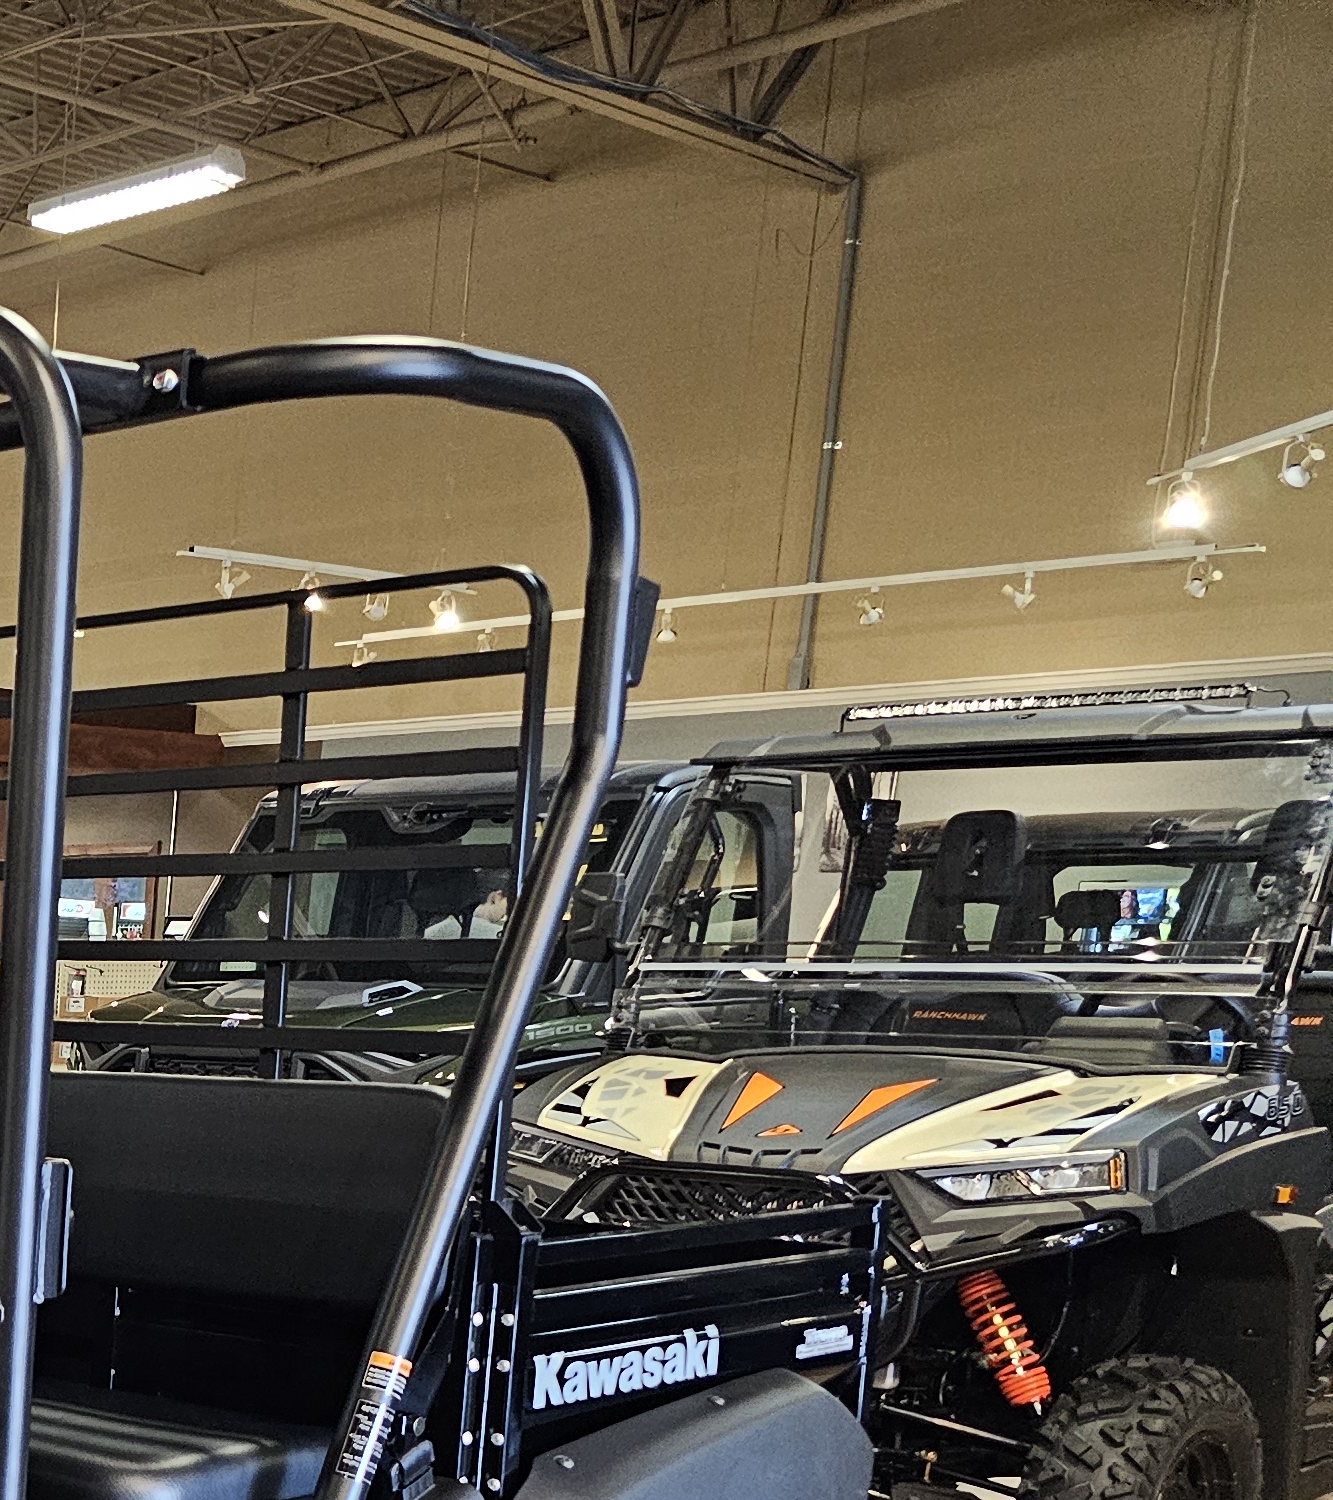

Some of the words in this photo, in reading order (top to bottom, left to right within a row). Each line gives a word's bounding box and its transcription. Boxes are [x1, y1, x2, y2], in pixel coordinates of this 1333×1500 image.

[912, 1010, 988, 1021] RANCHHAWK
[527, 1023, 592, 1041] 1500
[1266, 1091, 1305, 1119] 650
[533, 1324, 720, 1410] Kawasaki
